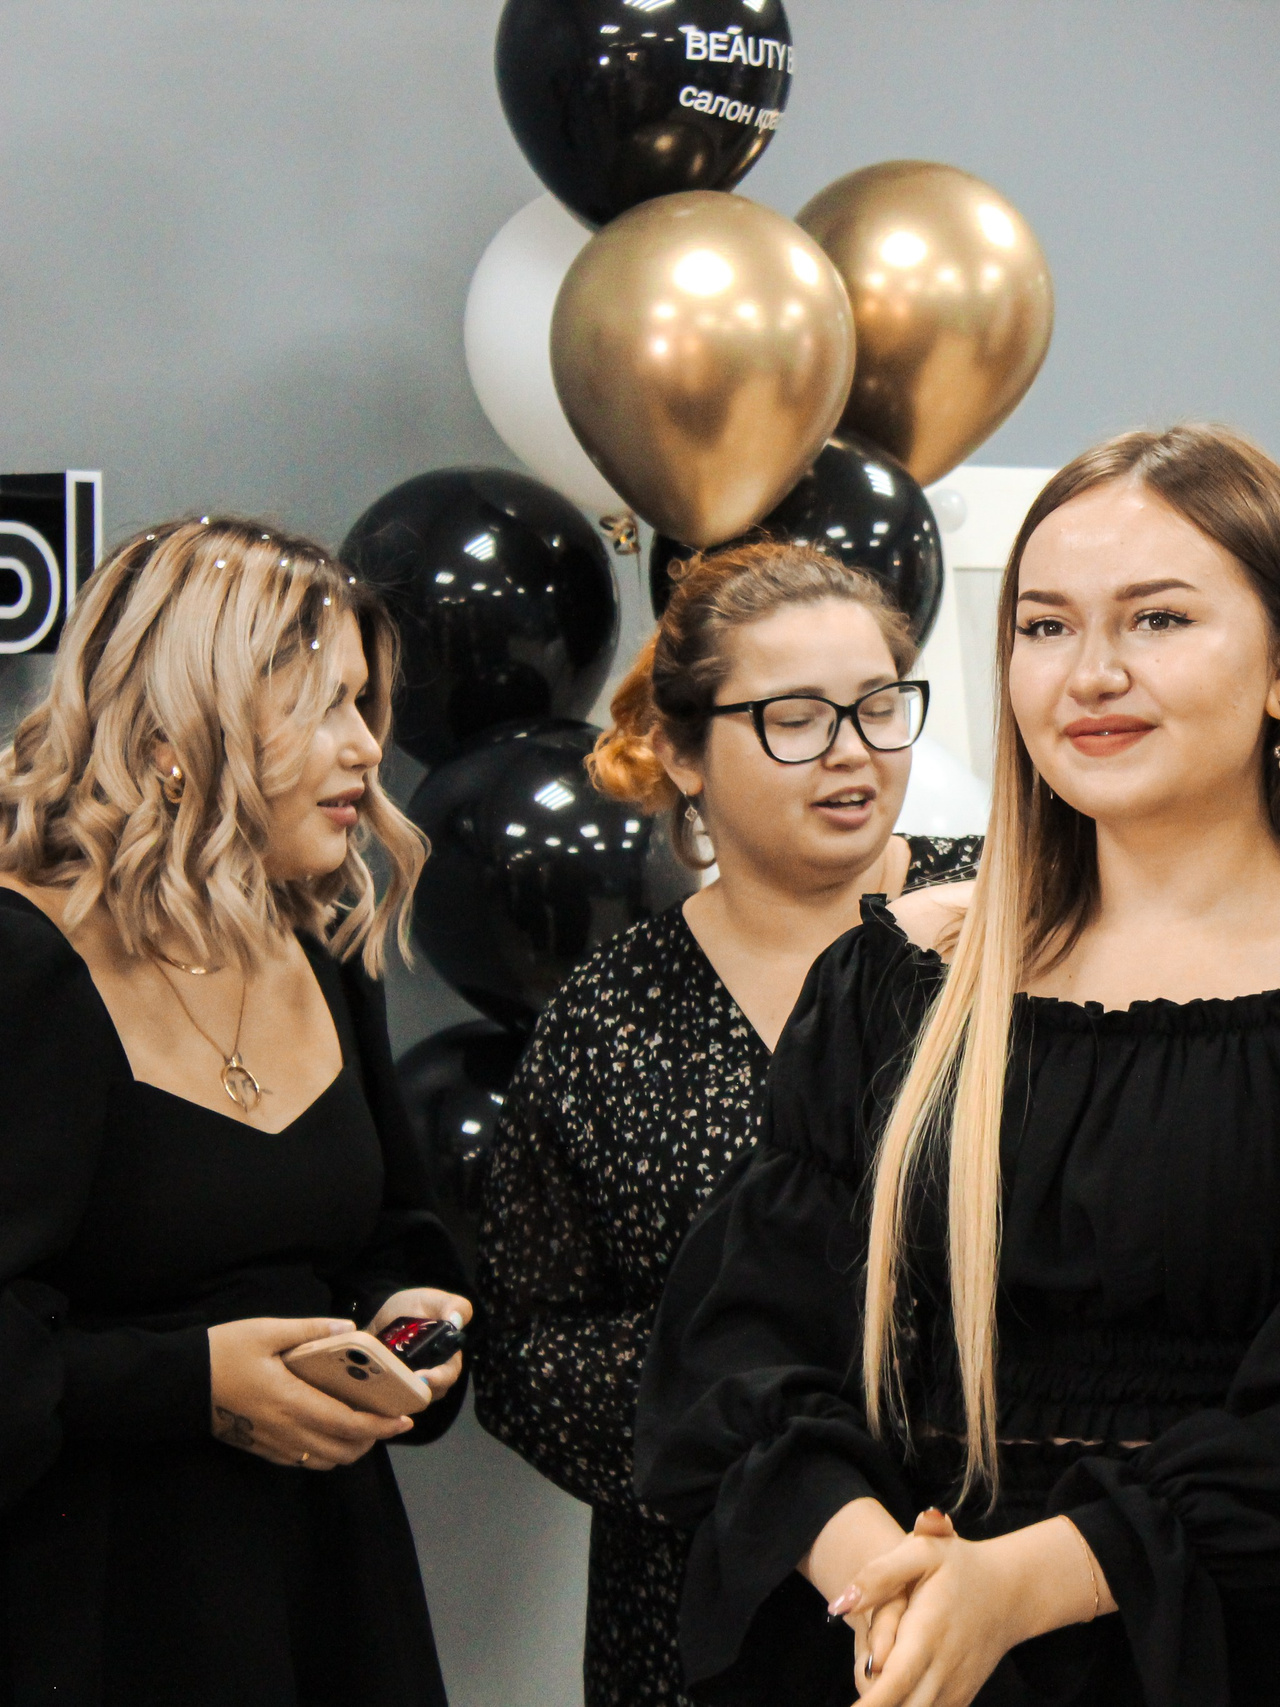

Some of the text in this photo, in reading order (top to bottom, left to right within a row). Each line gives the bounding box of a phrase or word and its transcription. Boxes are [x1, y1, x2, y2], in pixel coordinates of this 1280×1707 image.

[685, 30, 787, 71] BEAUTY
[678, 86, 783, 134] салон кра
